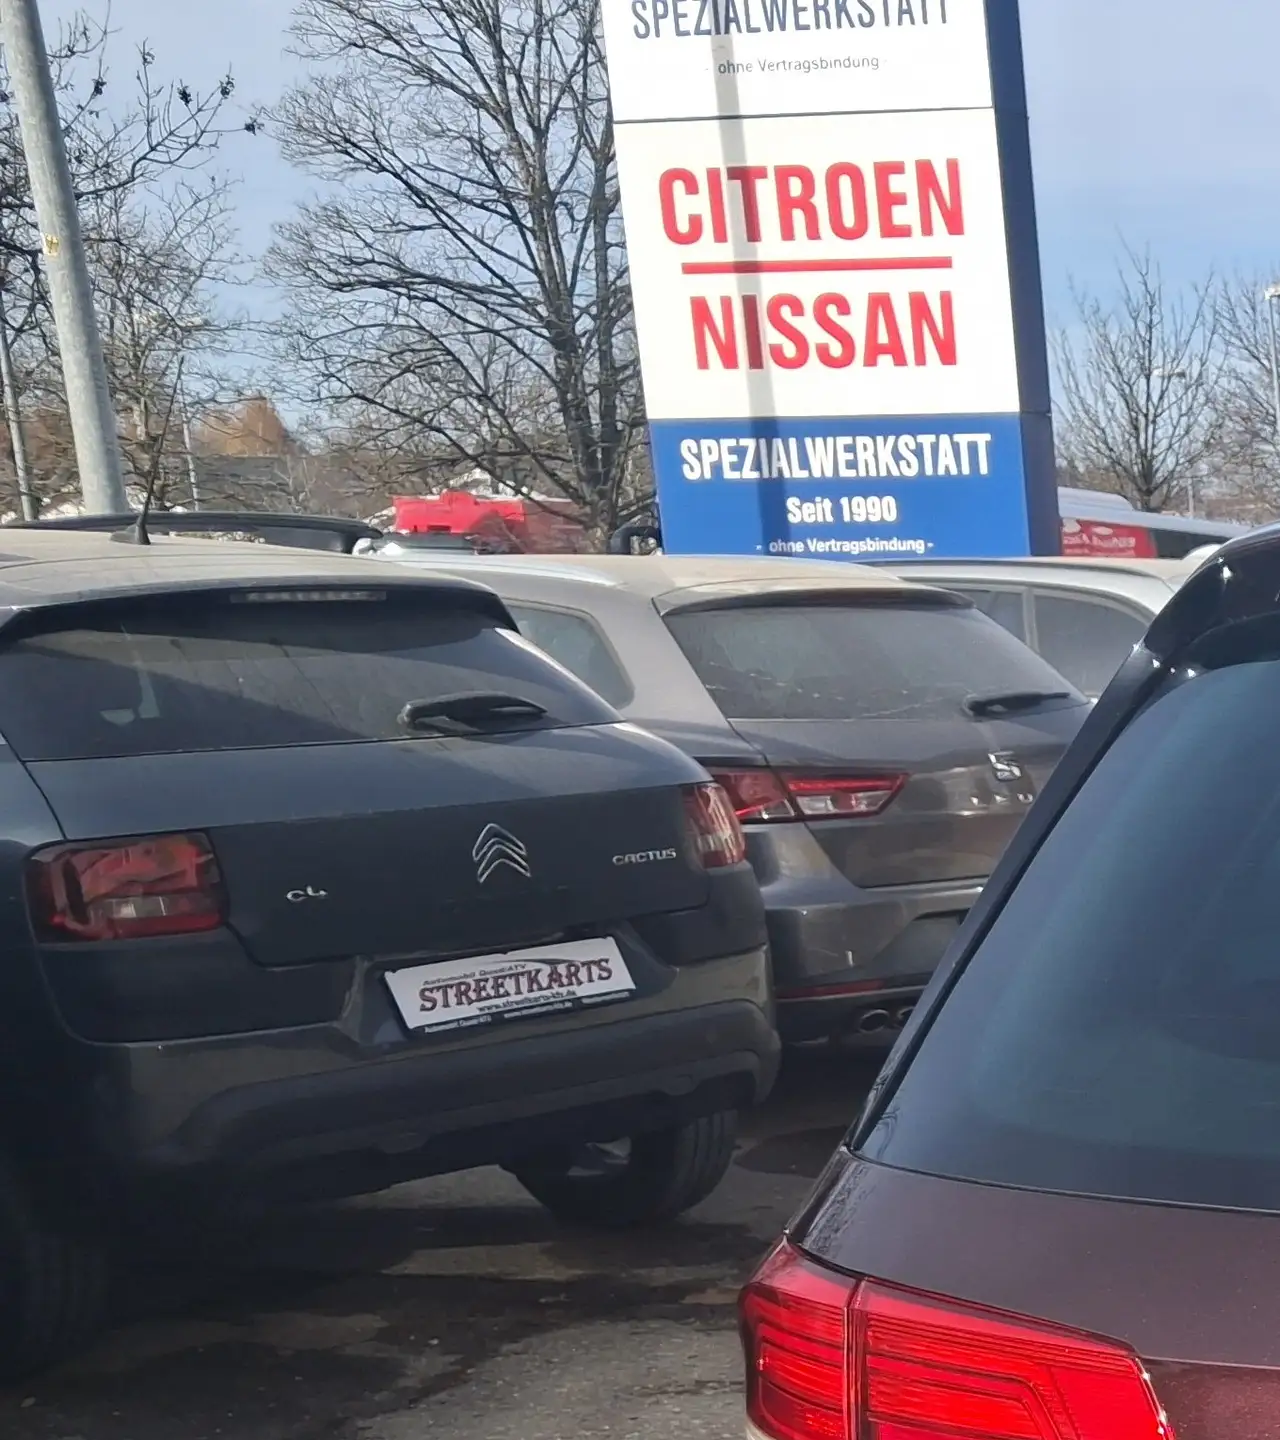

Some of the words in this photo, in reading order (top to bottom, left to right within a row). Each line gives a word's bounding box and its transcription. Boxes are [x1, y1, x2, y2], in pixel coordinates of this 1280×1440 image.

[632, 0, 948, 39] SPEZIALWERKSTATT
[717, 60, 753, 74] ohne
[758, 56, 879, 73] Vertragsbindung
[658, 158, 964, 244] CITROEN
[690, 290, 957, 369] NISSAN
[680, 434, 991, 480] SPEZIALWERKSTATT
[786, 497, 833, 523] Seit
[840, 496, 897, 522] 1990
[769, 540, 804, 552] ohne
[807, 537, 925, 554] Vertragsbindung
[613, 848, 677, 865] CACTUS
[418, 958, 613, 1013] STREETKARTS
